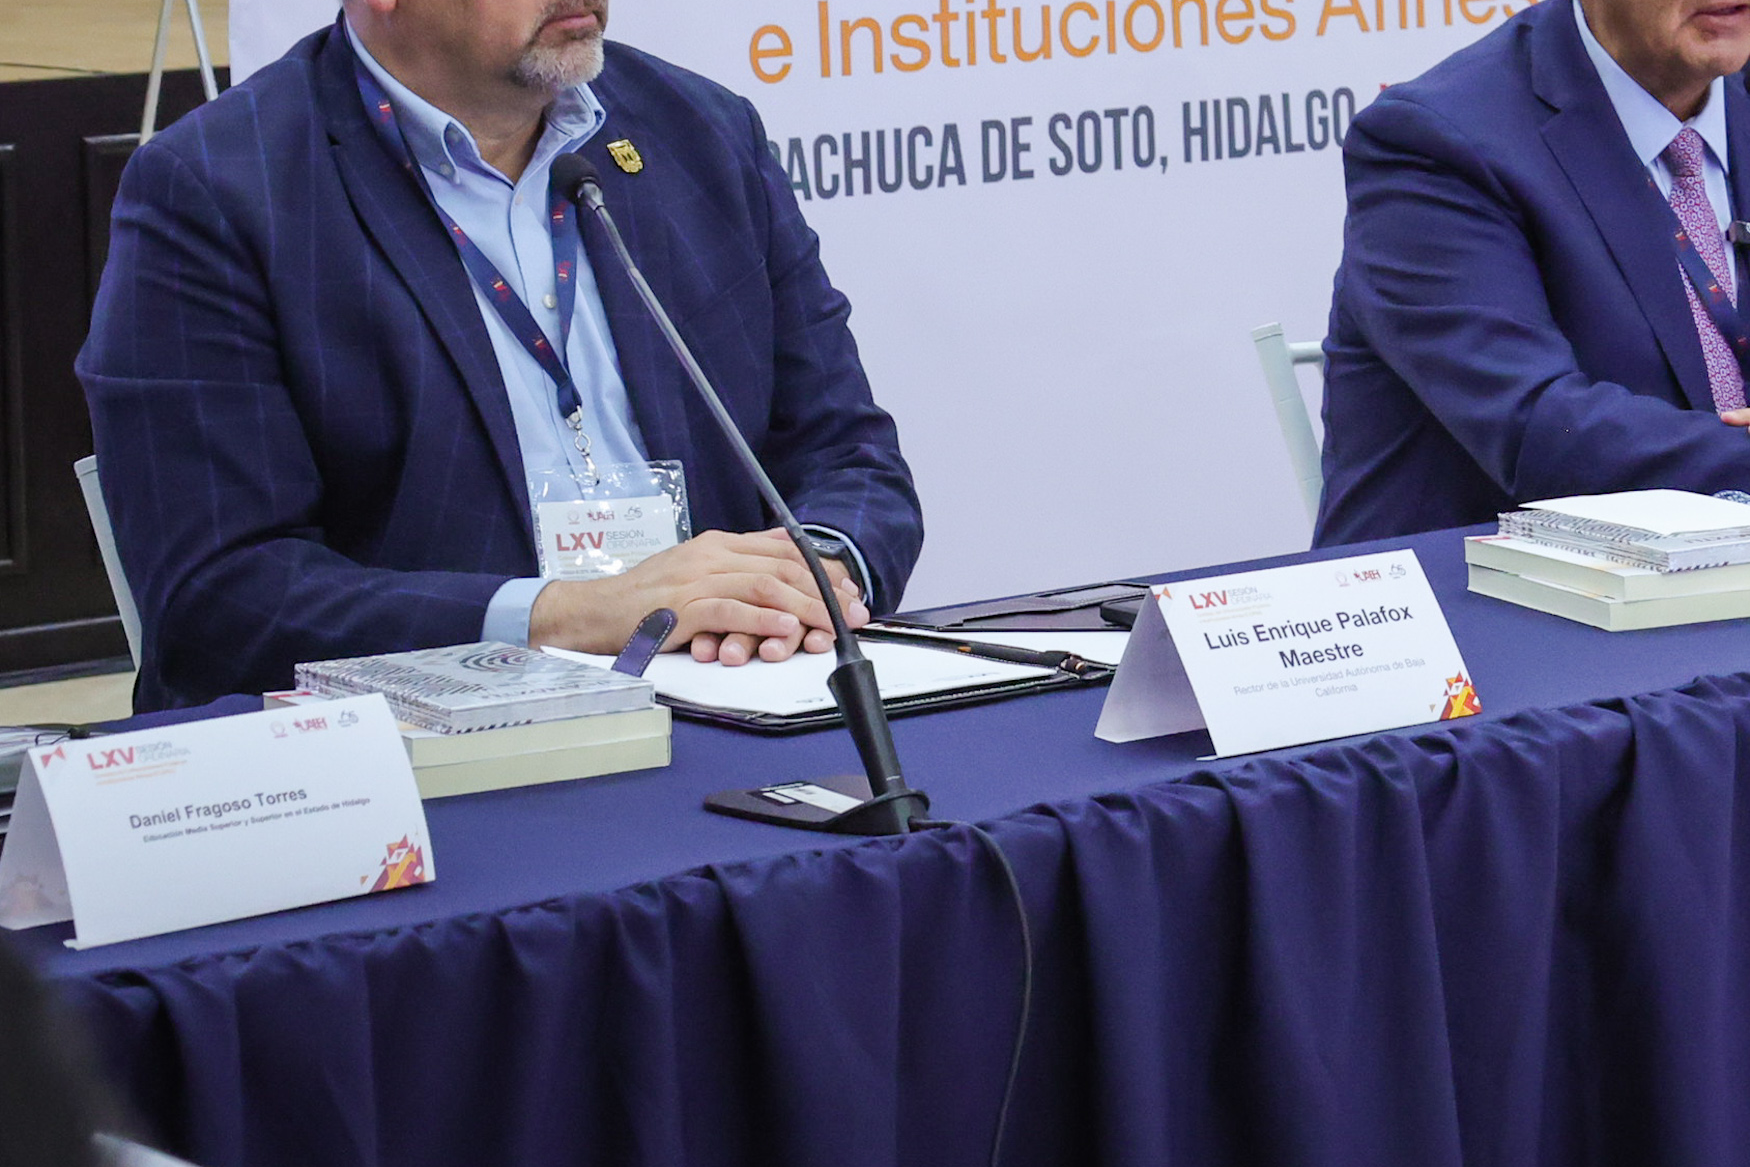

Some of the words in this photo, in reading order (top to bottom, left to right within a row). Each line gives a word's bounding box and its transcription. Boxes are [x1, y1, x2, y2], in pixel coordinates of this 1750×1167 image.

[748, 23, 794, 84] e
[981, 115, 1035, 184] DE
[1048, 104, 1169, 175] SOTO,
[1182, 87, 1356, 164] HIDALGO
[555, 531, 605, 552] LXV
[1188, 589, 1228, 610] LXV
[1203, 628, 1250, 650] Luis
[1252, 618, 1334, 642] Enrique
[1336, 605, 1414, 630] Palafox
[1278, 642, 1365, 669] Maestre
[1234, 683, 1265, 696] Rector
[1267, 681, 1279, 691] de
[1281, 679, 1290, 689] la
[1291, 670, 1344, 687] Universidad
[1345, 662, 1391, 678] Autónoma
[1392, 660, 1404, 670] de
[1406, 657, 1426, 668] Baja
[1315, 683, 1358, 697] California
[86, 746, 135, 770] LXV
[129, 805, 182, 829] Daniel
[186, 797, 251, 818] Fragoso
[254, 788, 308, 808] Torres
[210, 820, 242, 833] Superior
